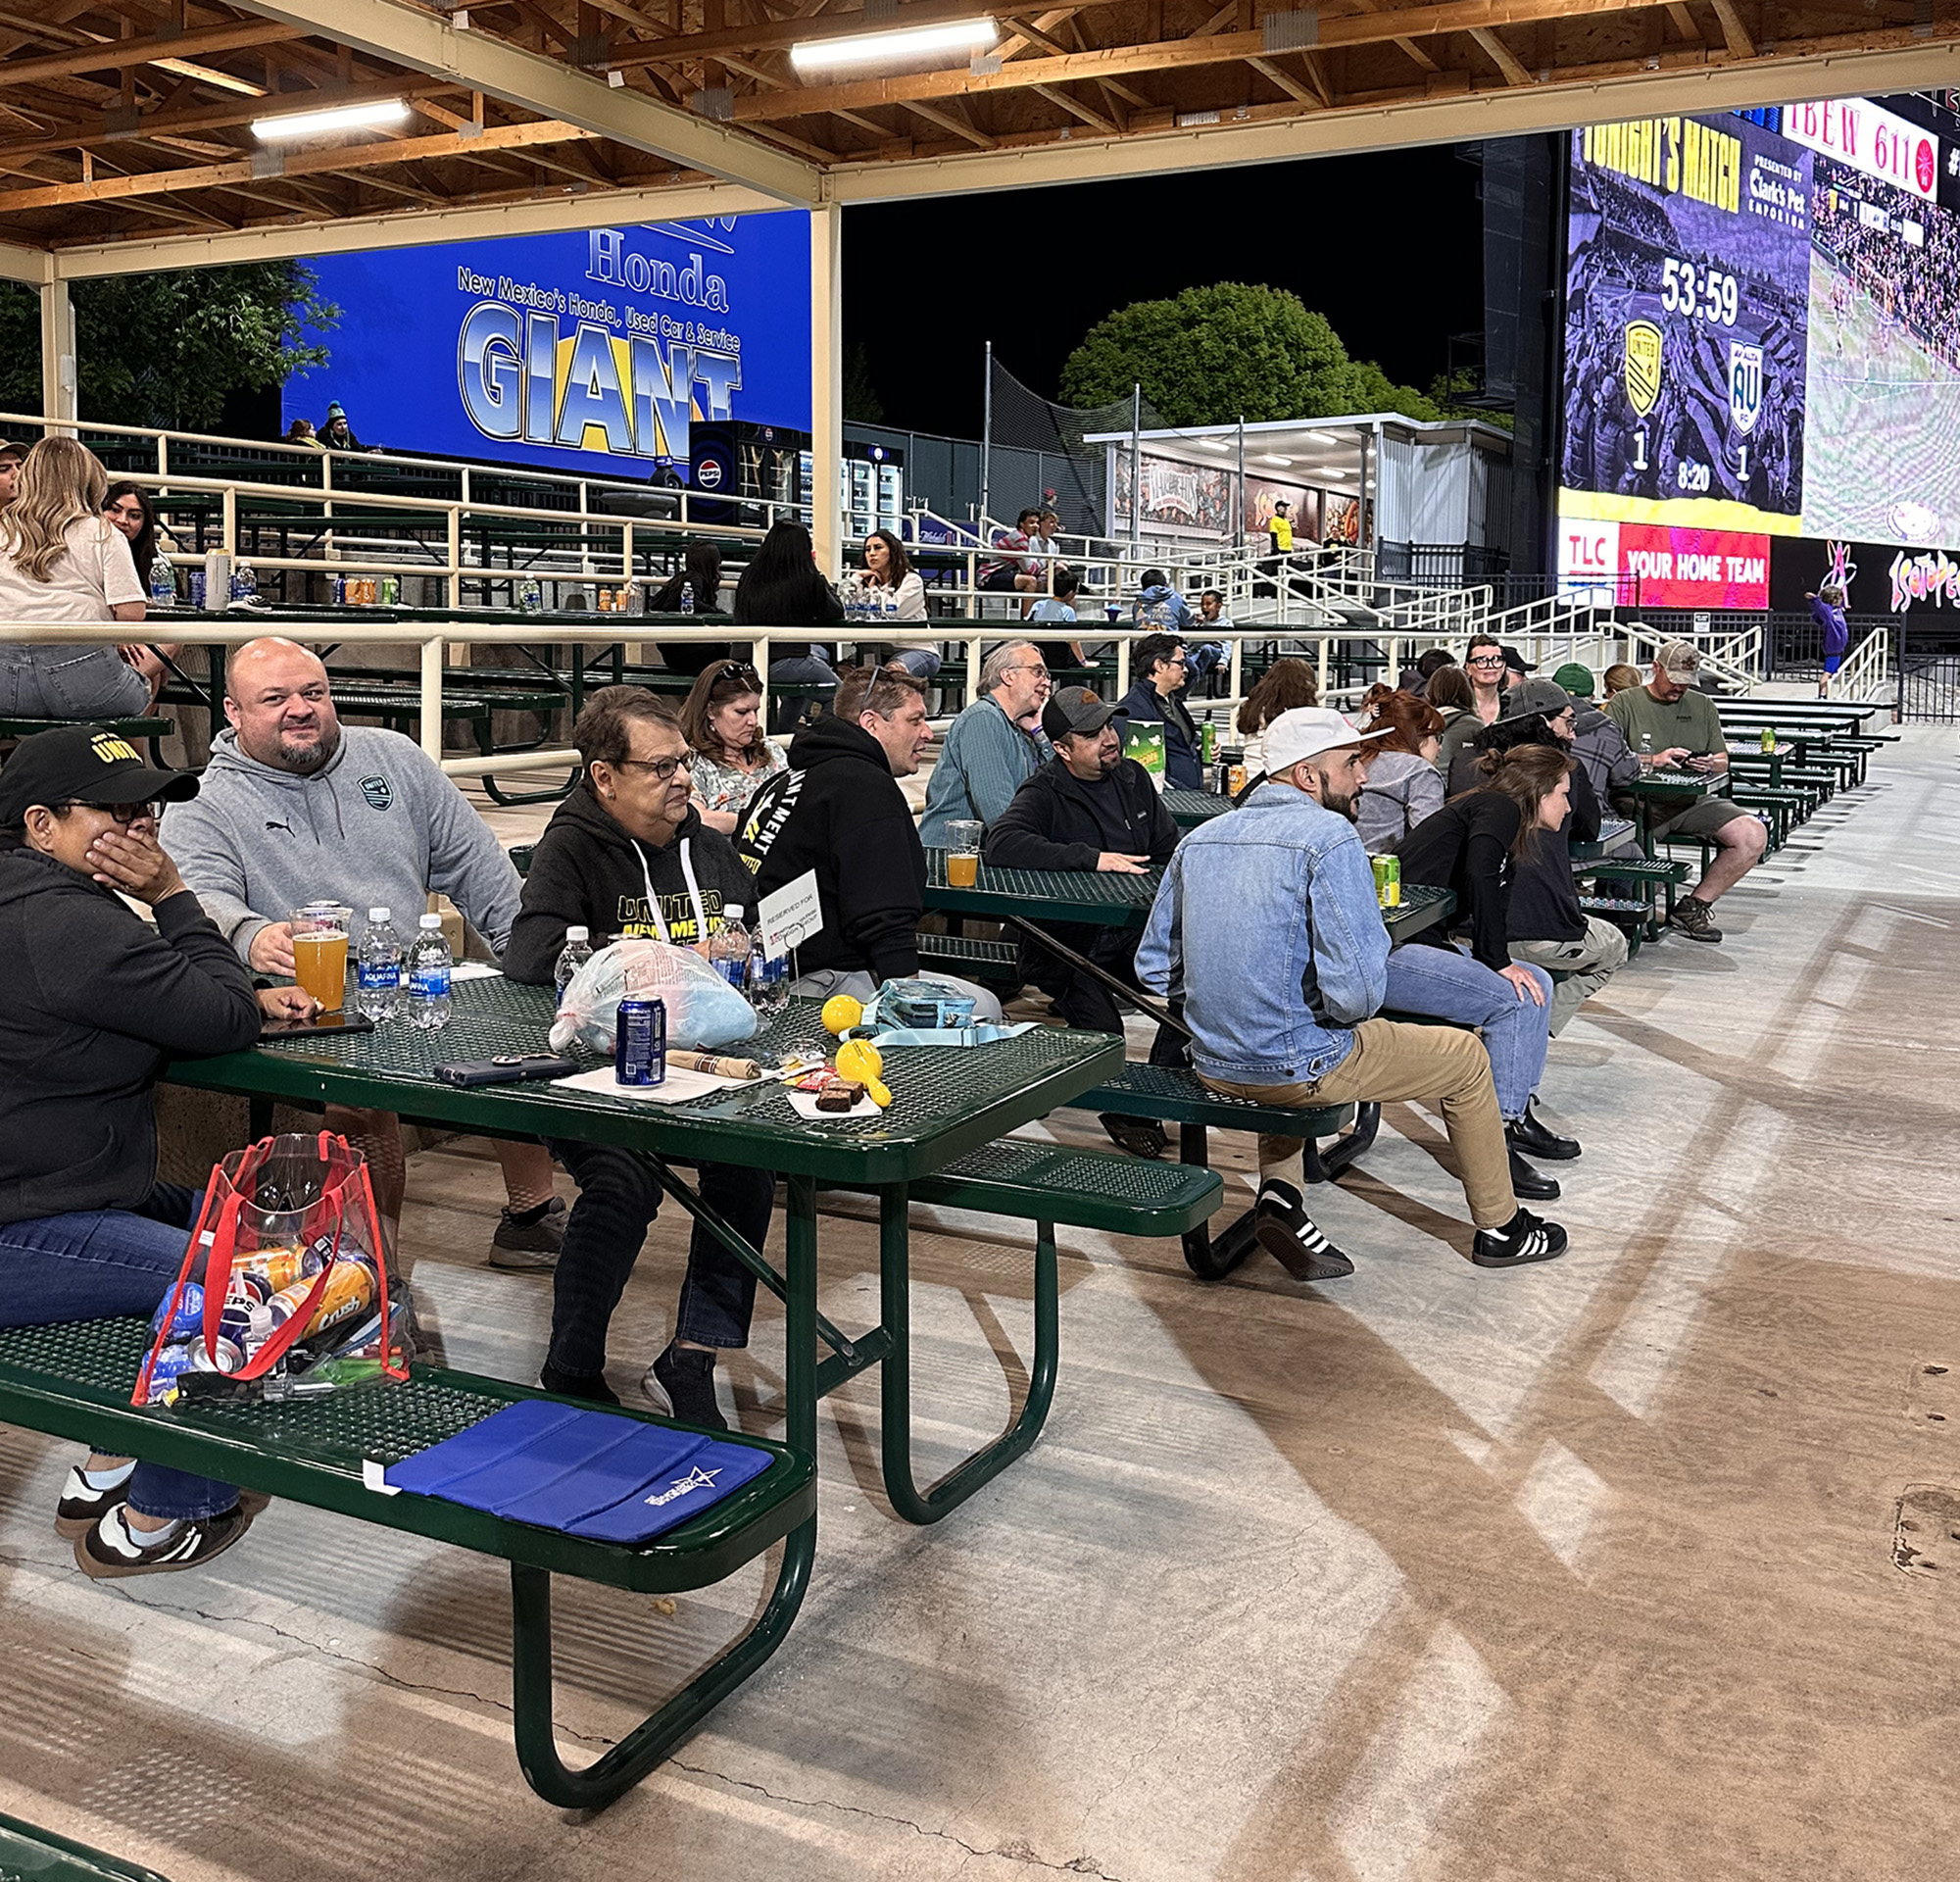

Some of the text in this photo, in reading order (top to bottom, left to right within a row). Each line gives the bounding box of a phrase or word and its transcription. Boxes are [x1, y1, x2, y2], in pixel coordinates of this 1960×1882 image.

[1791, 100, 1860, 157] IBEW
[1875, 123, 1910, 180] 611
[1683, 119, 1741, 214] MATCH
[1754, 154, 1802, 184] PRESENTED BY
[1749, 168, 1805, 215] Clark's Pet
[1748, 199, 1805, 230] EMPORIUM
[586, 228, 729, 314] Honda
[458, 266, 741, 352] New Mexico's Honda, Used Car & Service
[1661, 257, 1739, 327] 53:59
[1743, 352, 1758, 363] ALTA
[458, 299, 742, 466] GIANT
[1733, 362, 1758, 413] AU
[1633, 431, 1648, 470] 1
[1736, 445, 1750, 481] 1
[1677, 462, 1710, 491] 8:20
[1569, 535, 1606, 567] TLC
[1627, 550, 1765, 584] YOUR HOME TEAM
[616, 888, 724, 923] UNITED
[767, 902, 801, 926] RESERVED
[801, 893, 813, 907] FOR
[364, 971, 397, 981] AQUAFINA
[409, 981, 430, 992] AFINA
[225, 1295, 256, 1312] EPS
[318, 1295, 361, 1332] Crush
